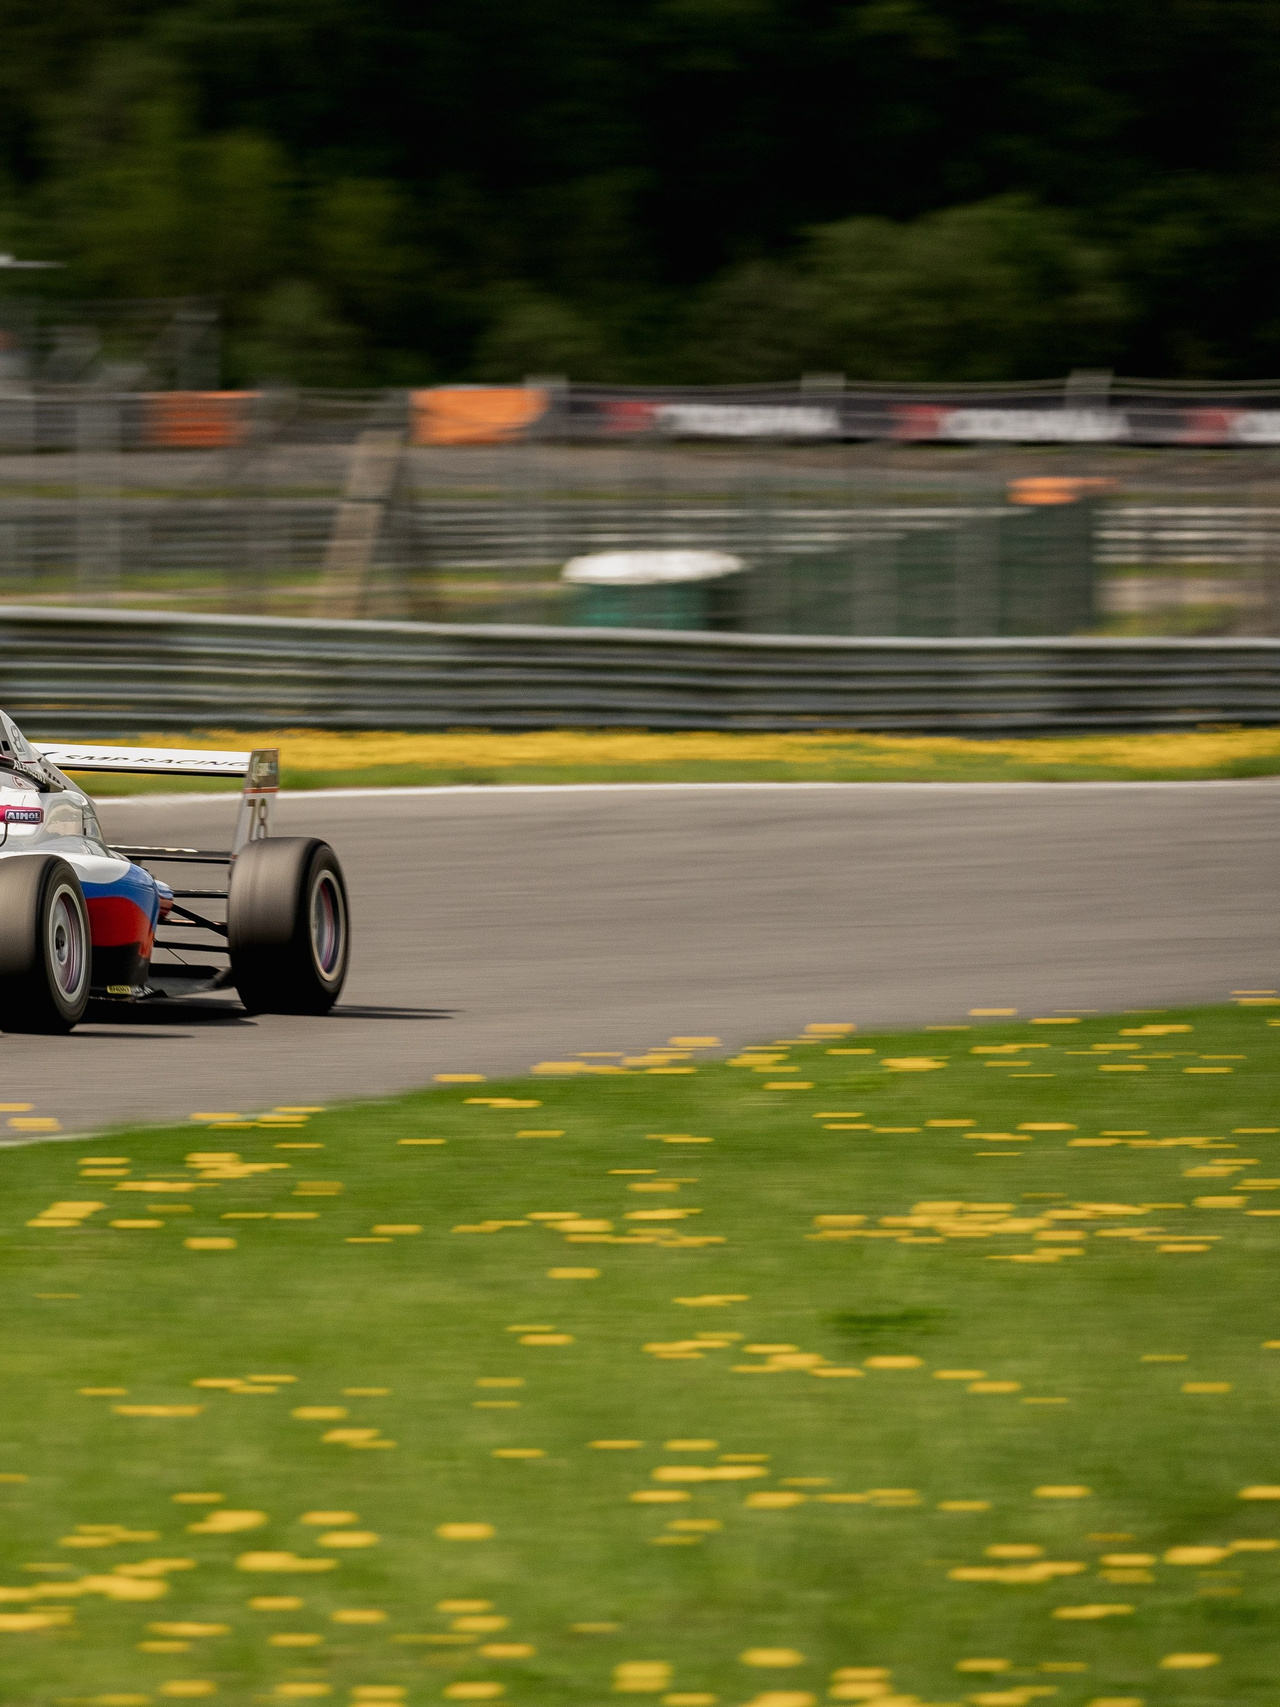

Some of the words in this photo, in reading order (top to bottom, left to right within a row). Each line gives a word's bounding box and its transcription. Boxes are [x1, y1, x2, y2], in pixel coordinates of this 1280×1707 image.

[61, 754, 129, 762] SMP
[133, 757, 249, 767] RACING
[7, 811, 40, 820] AIMOL
